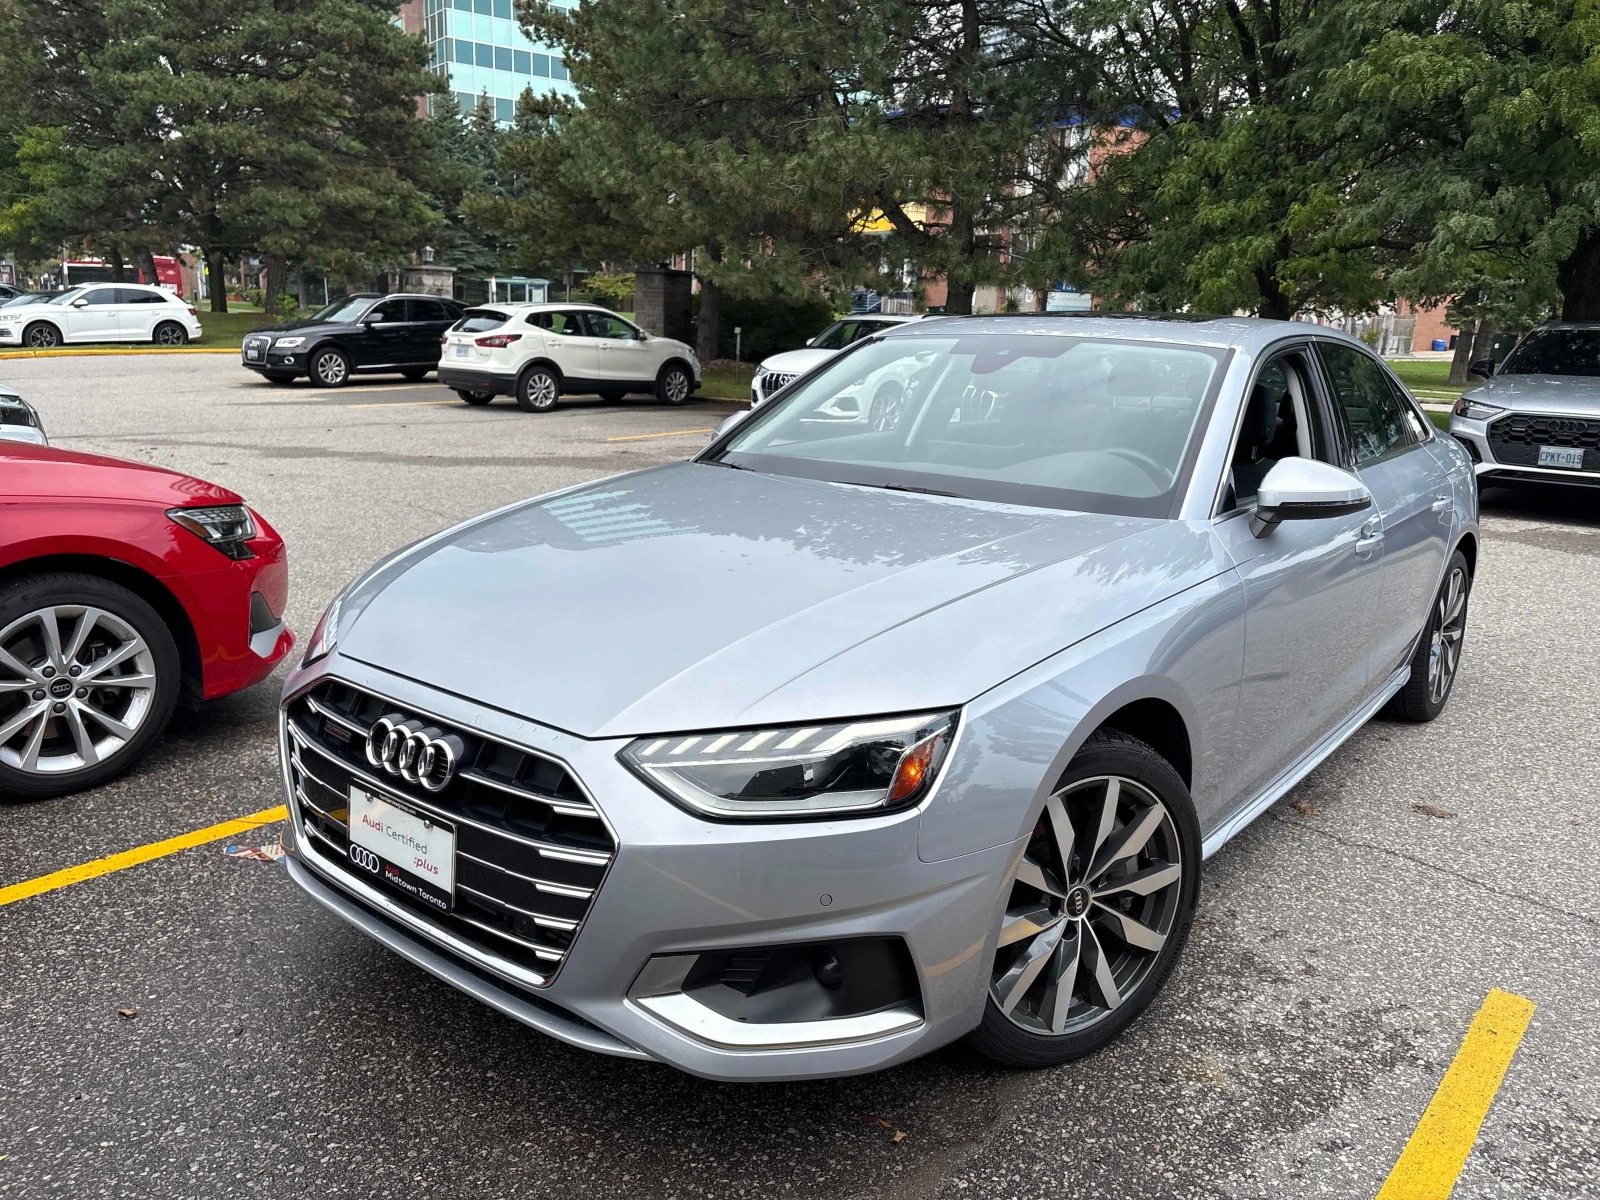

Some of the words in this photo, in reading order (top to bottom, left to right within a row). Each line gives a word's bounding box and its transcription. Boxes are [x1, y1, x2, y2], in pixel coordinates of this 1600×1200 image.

[362, 814, 383, 833] Audi
[386, 826, 427, 855] Certified
[384, 863, 400, 876] Audi
[385, 871, 417, 894] Midtown
[418, 887, 447, 910] Toronto
